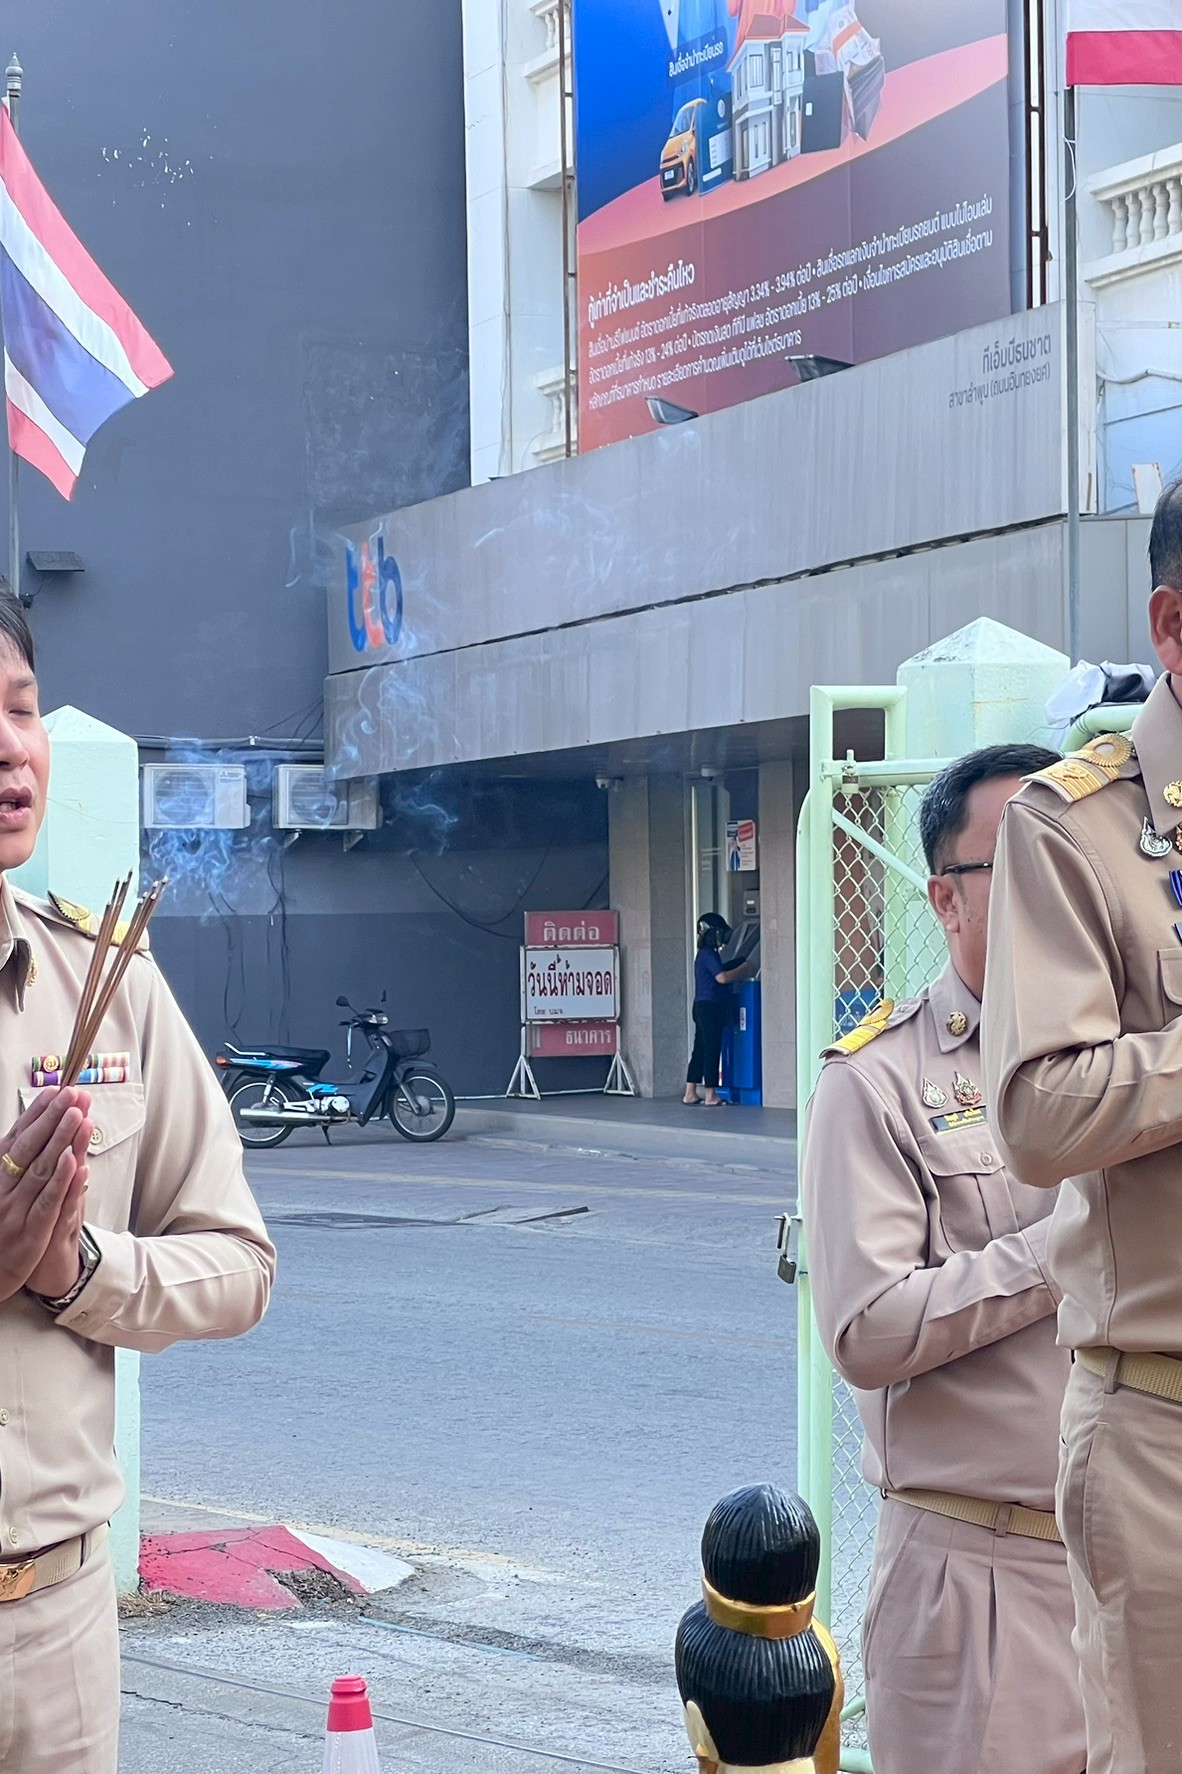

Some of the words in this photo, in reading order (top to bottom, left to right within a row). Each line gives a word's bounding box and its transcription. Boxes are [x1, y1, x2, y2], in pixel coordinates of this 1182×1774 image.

[588, 259, 695, 328] กู้เท่าที่จำเป็นและชำระคืนไหว
[750, 280, 770, 301] 3.34%
[775, 270, 796, 293] 3.94%
[796, 262, 812, 285] ต่อปี
[808, 290, 821, 311] 13%
[826, 282, 842, 304] 25%
[842, 273, 858, 297] ต่อปี
[982, 334, 1052, 374] ทีเอ็มบีธนชาต
[948, 381, 990, 408] สาขาลำพูน
[543, 920, 600, 942] ติดต่อ
[527, 953, 613, 997] วันนี้ห้ามจอด
[565, 1029, 611, 1045] ธนาคาร
